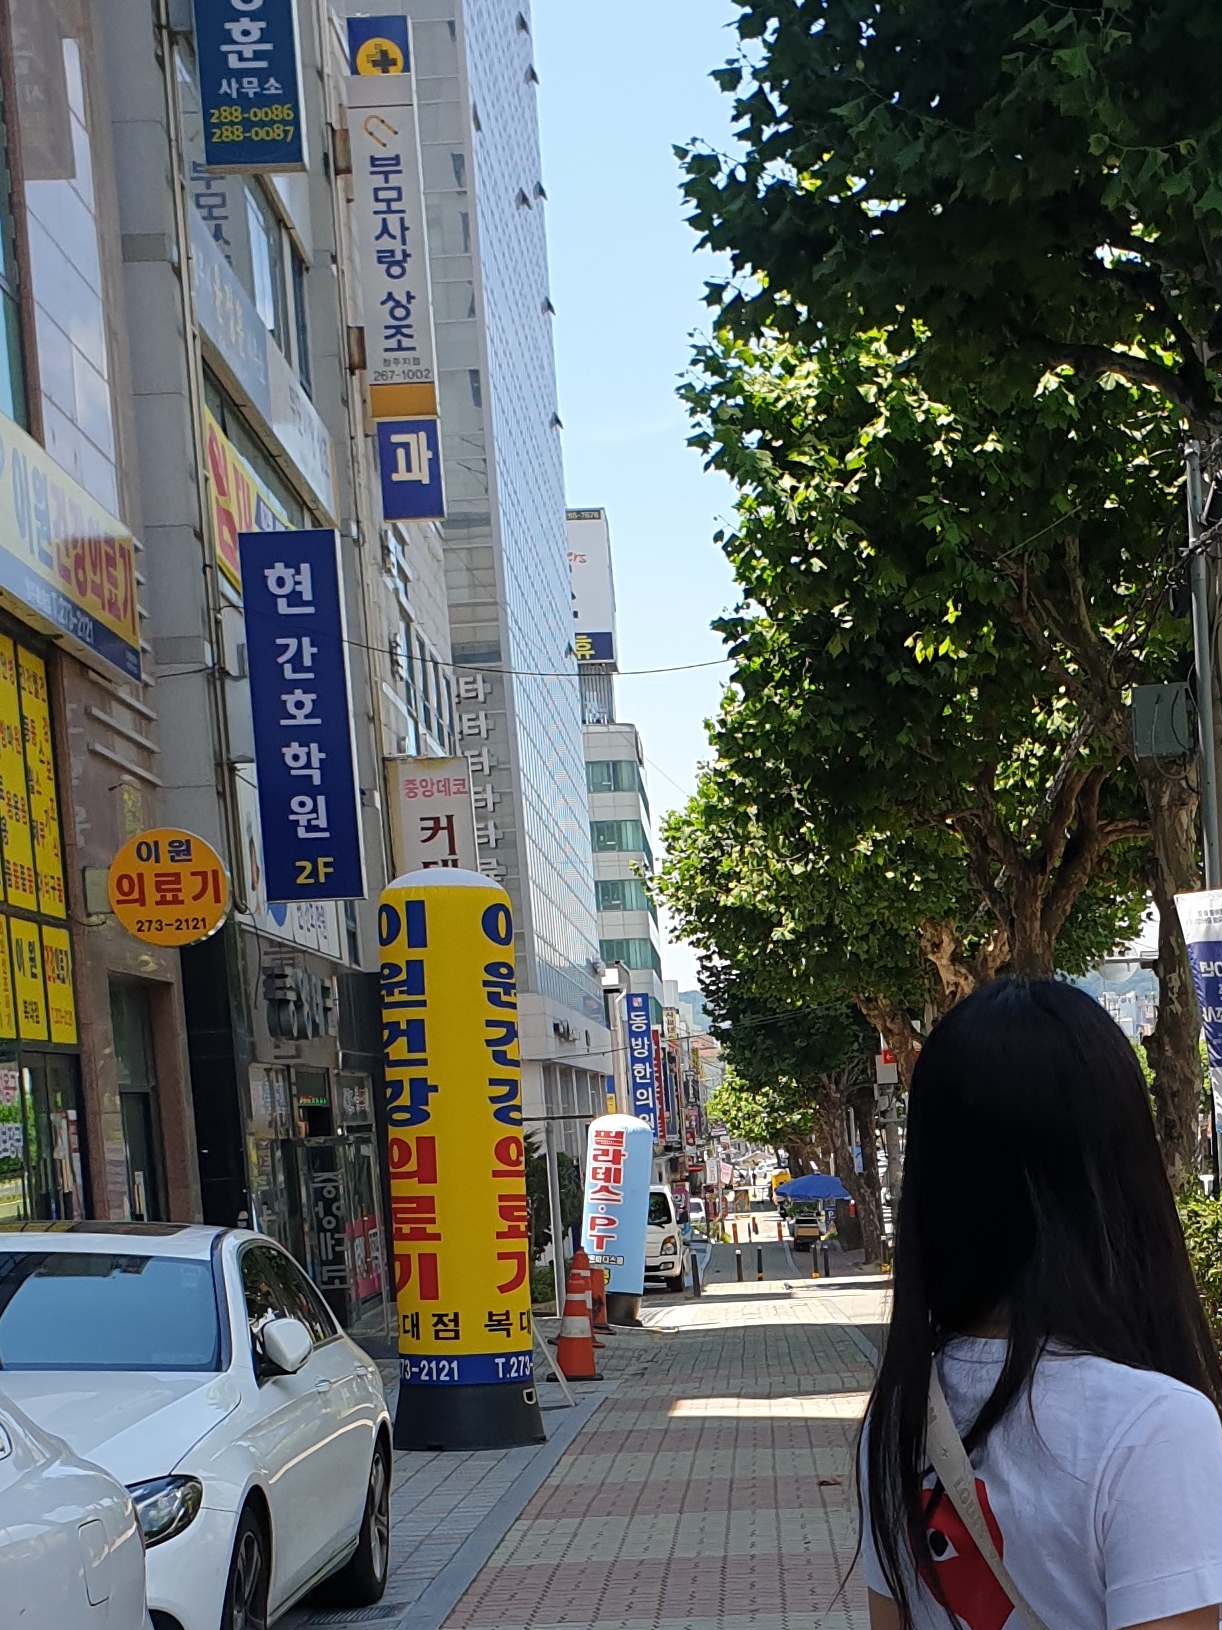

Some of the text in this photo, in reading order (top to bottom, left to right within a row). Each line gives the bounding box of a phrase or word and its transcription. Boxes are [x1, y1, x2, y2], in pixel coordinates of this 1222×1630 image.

[218, 77, 284, 99] 사무소
[210, 104, 295, 123] 288-0086
[210, 124, 295, 142] 288-0087
[369, 153, 417, 353] 부모사랑 상조
[373, 368, 432, 381] 267-1002
[389, 431, 433, 484] 과
[403, 777, 469, 799] 중앙데코
[135, 838, 193, 866] 이원
[294, 856, 335, 884] 2F
[115, 868, 222, 907] 의료기
[135, 917, 207, 933] 273-2121
